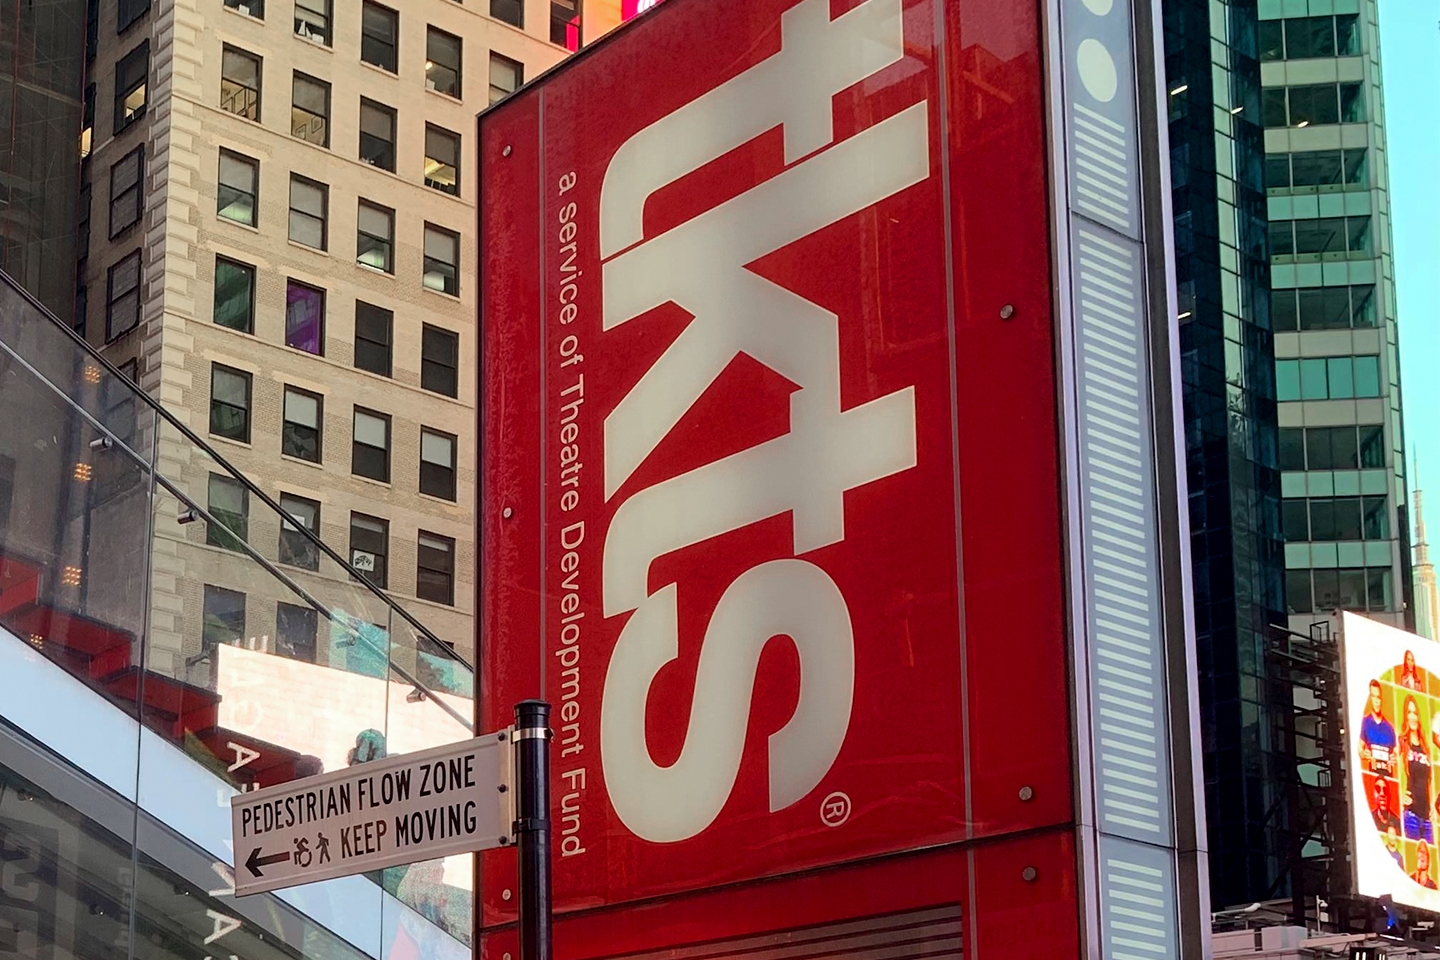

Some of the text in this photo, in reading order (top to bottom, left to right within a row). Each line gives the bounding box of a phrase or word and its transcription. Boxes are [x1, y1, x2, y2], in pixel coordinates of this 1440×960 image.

[555, 171, 586, 858] a service of Theatre Development Fund
[599, 0, 930, 844] tkts
[241, 754, 476, 838] PEDESTRIAN FLOW ZONE
[340, 801, 477, 859] KEEP MOVING
